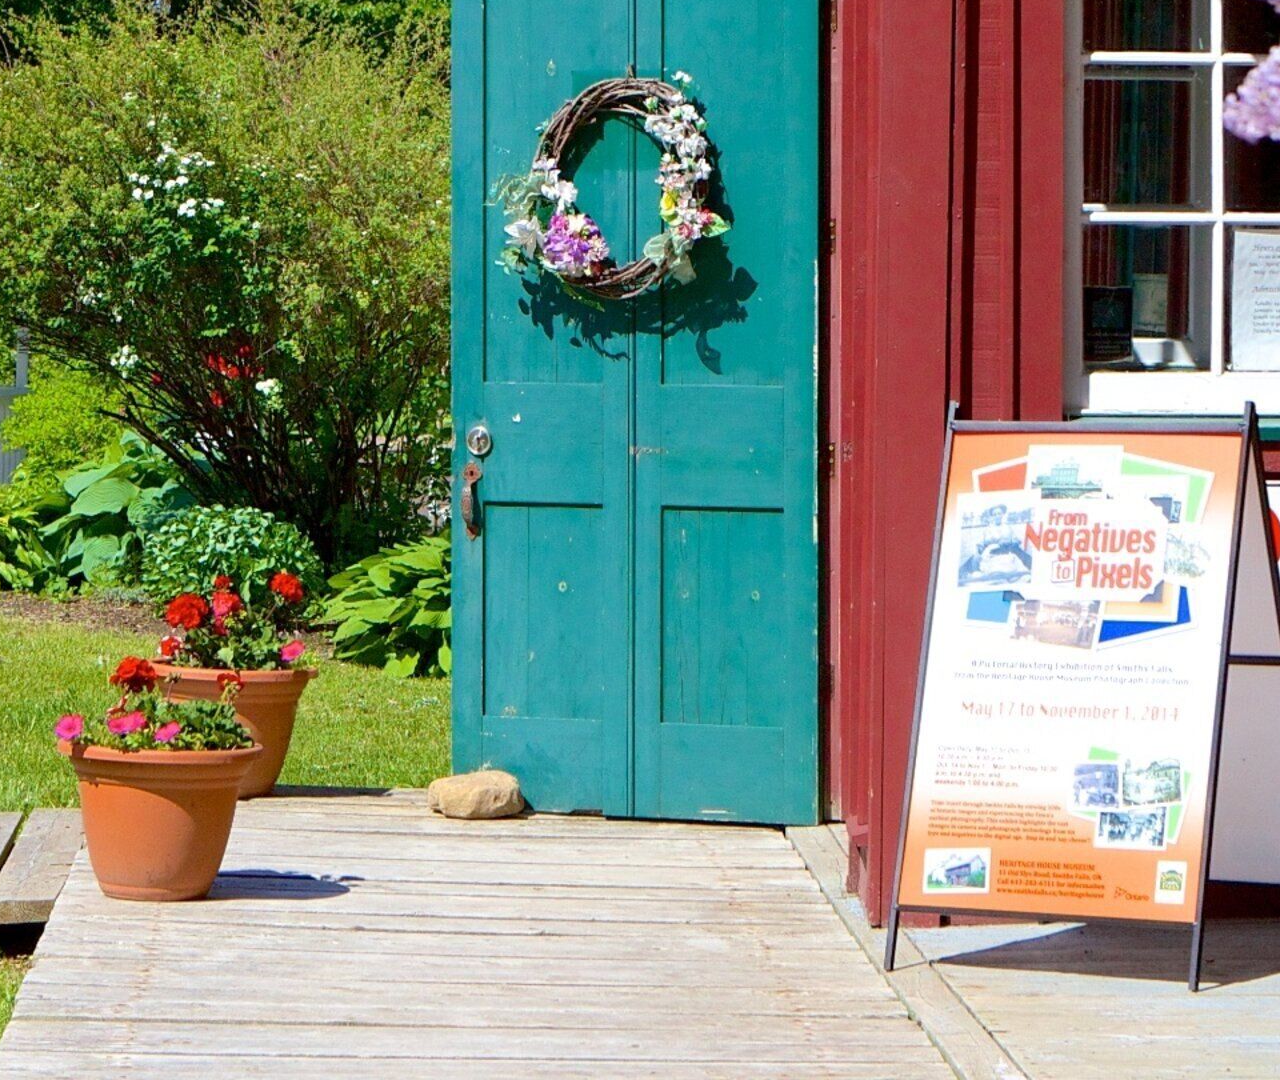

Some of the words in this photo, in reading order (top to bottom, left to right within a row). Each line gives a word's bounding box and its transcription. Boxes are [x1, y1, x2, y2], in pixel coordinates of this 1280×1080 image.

[1049, 509, 1088, 526] From
[1023, 521, 1157, 561] Negatives
[1056, 564, 1070, 579] to
[1075, 556, 1153, 589] Pixels
[979, 660, 1018, 669] Pictorial
[1019, 661, 1053, 671] History
[1055, 662, 1102, 671] Exhibition
[1117, 664, 1148, 672] Smiths
[991, 673, 1027, 681] Heritage
[1094, 675, 1144, 685] Photograph
[961, 701, 993, 718] May
[999, 701, 1016, 717] 17
[1020, 702, 1035, 717] to
[1040, 704, 1119, 719] November
[1125, 706, 1136, 721] 1,
[1141, 706, 1179, 722] 2014
[1000, 860, 1035, 868] HERITAGE
[1037, 861, 1060, 869] HOUSE
[1063, 862, 1095, 871] MUSEUM
[1067, 881, 1105, 889] information
